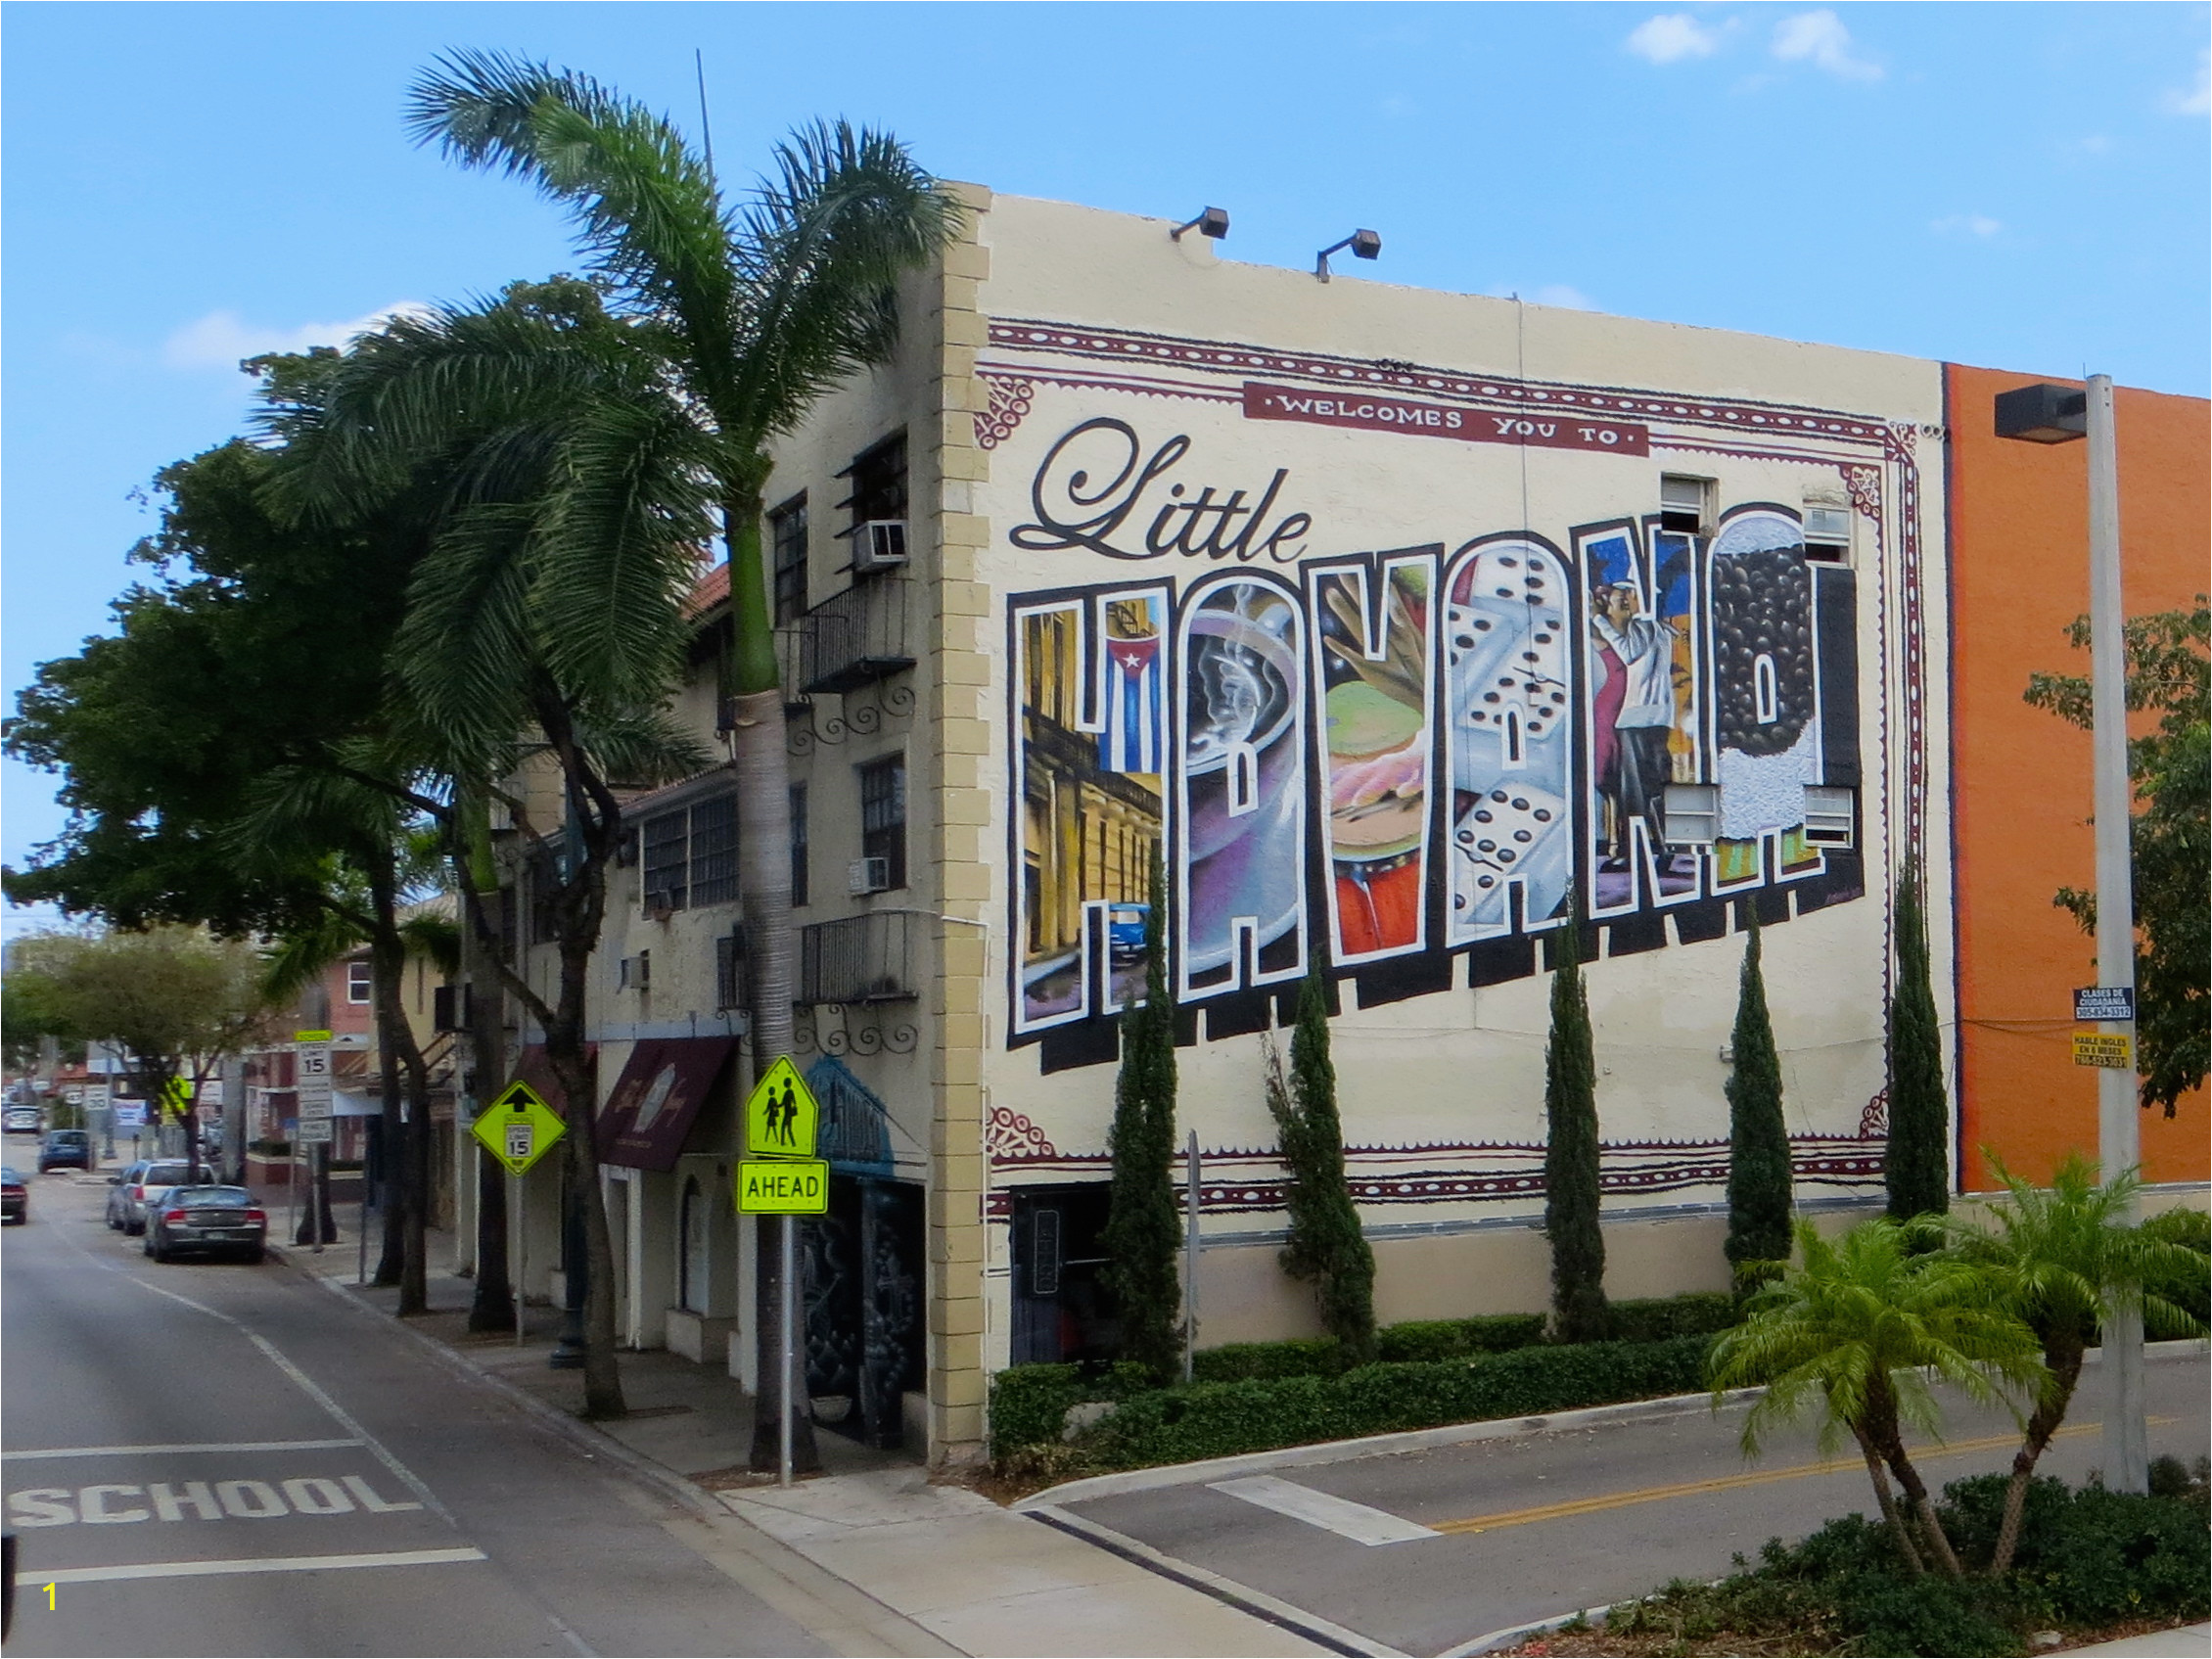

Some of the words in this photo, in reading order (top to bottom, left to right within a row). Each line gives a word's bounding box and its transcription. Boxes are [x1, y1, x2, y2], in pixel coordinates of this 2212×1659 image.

[1276, 394, 1463, 429] WELCOMES
[1492, 416, 1556, 438] YOU
[1578, 427, 1619, 444] TO
[1009, 417, 1313, 563] Little
[1007, 501, 1864, 1074] HAVANA
[2081, 989, 2111, 997] CLASES
[2113, 989, 2124, 997] DE
[304, 1058, 325, 1073] 15
[510, 1141, 529, 1155] 15
[747, 1176, 819, 1198] AHEAD
[7, 1475, 424, 1528] SCHOOL
